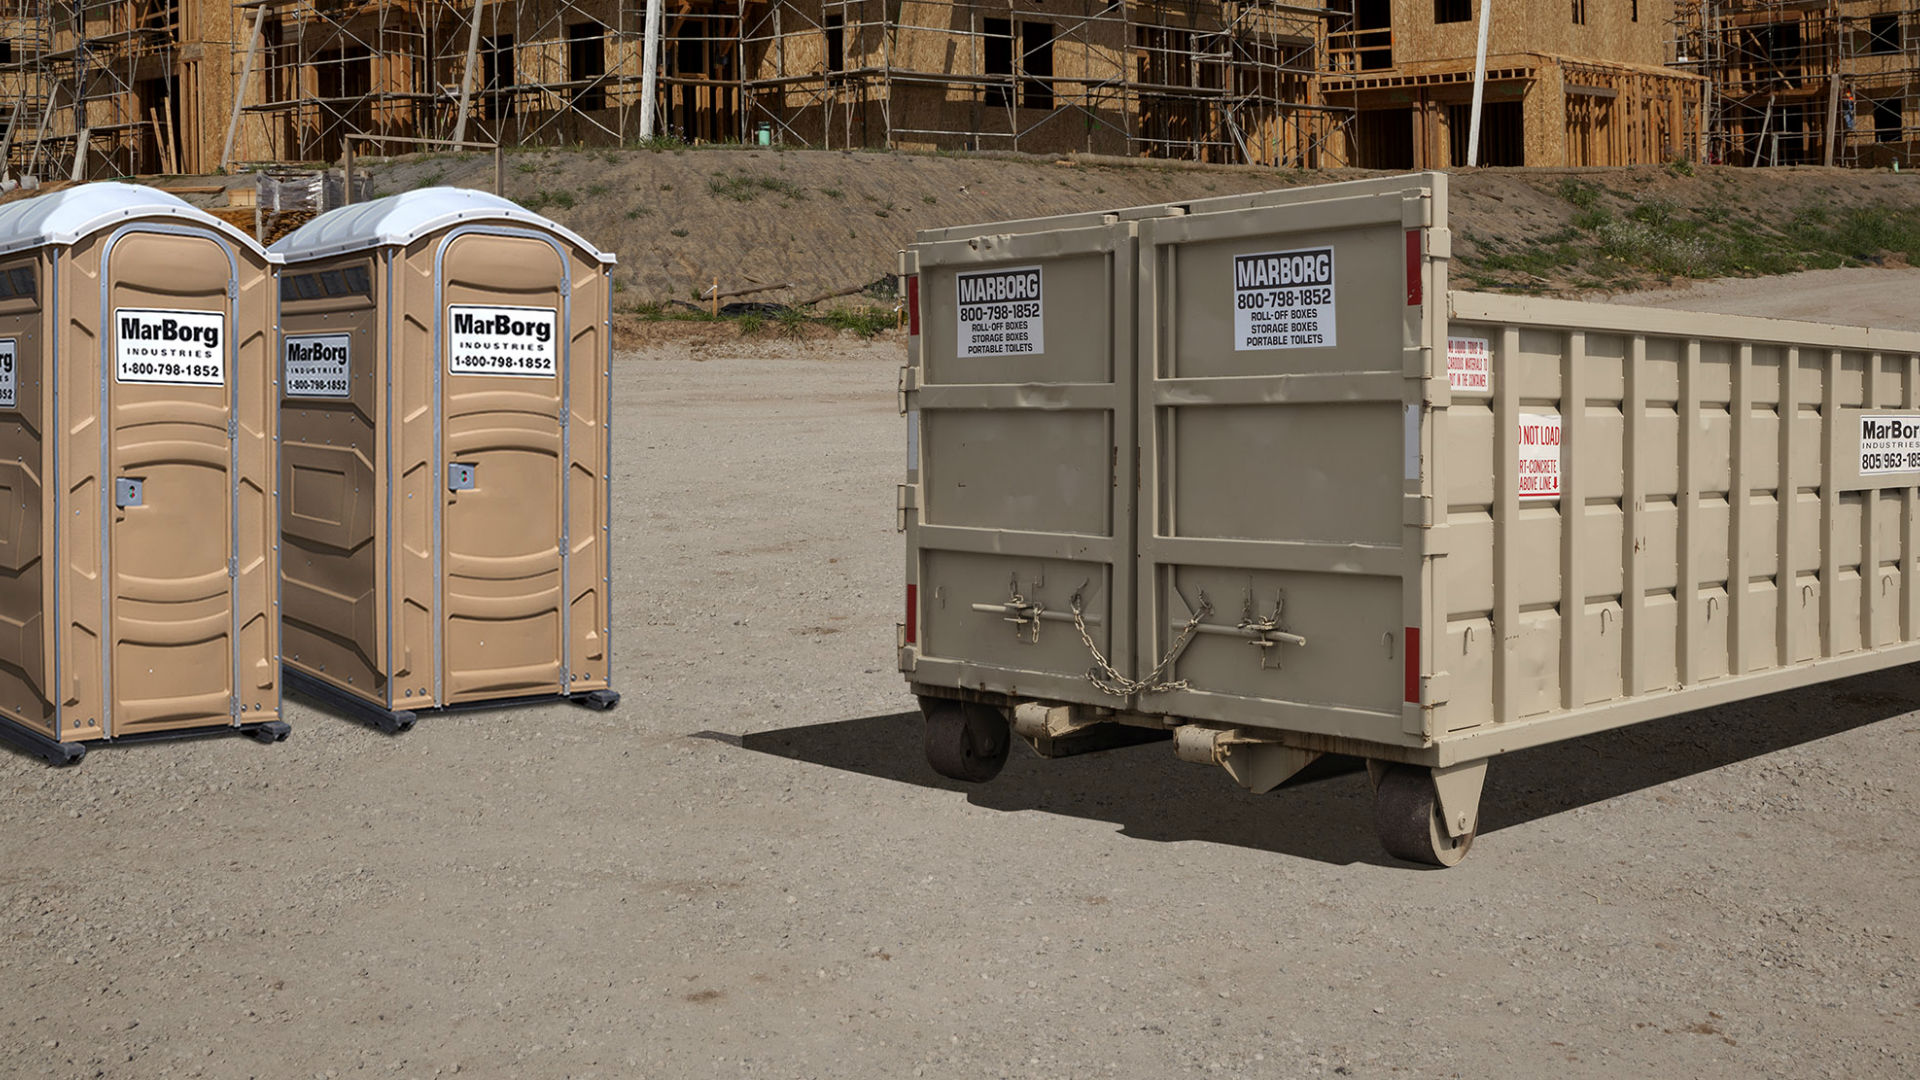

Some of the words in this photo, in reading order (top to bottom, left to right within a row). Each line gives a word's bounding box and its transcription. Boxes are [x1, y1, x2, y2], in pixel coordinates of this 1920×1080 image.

[1237, 254, 1329, 288] MARBORG
[960, 273, 1038, 303] MARBORG
[1237, 288, 1331, 309] 800-798-1852
[960, 303, 1040, 321] 800-798-1852
[1251, 310, 1289, 321] ROLL-OFF
[1291, 308, 1318, 319] BOXES
[121, 317, 218, 348] MarBorg
[454, 313, 551, 343] MarBorg
[972, 322, 1004, 332] ROLL-OFF
[1005, 320, 1028, 331] BOXES
[1251, 323, 1288, 334] STORAGE
[1291, 321, 1318, 332] BOXES
[972, 333, 1003, 343] STORAGE
[1006, 331, 1029, 342] BOXES
[1247, 335, 1288, 347] PORTABLE
[1290, 333, 1323, 345] TOILETS
[127, 348, 212, 358] INDUSTRIES
[288, 342, 347, 365] MarBorg
[460, 342, 544, 352] INDUSTRIES
[968, 344, 1003, 354] PORTABLE
[1005, 342, 1033, 353] TOILETS
[122, 362, 219, 377] 1-800-798-1852
[455, 355, 551, 369] 1-800-798-1852
[1523, 425, 1539, 446] NOT
[1541, 425, 1560, 446] LOAD
[1863, 420, 1920, 440] MarBor
[1862, 441, 1920, 449] INDUSTRIES
[1519, 459, 1557, 474] RT-CONCRETE
[1862, 453, 1882, 470] 805
[1519, 476, 1538, 491] ABOVE
[1539, 475, 1552, 491] LINE
